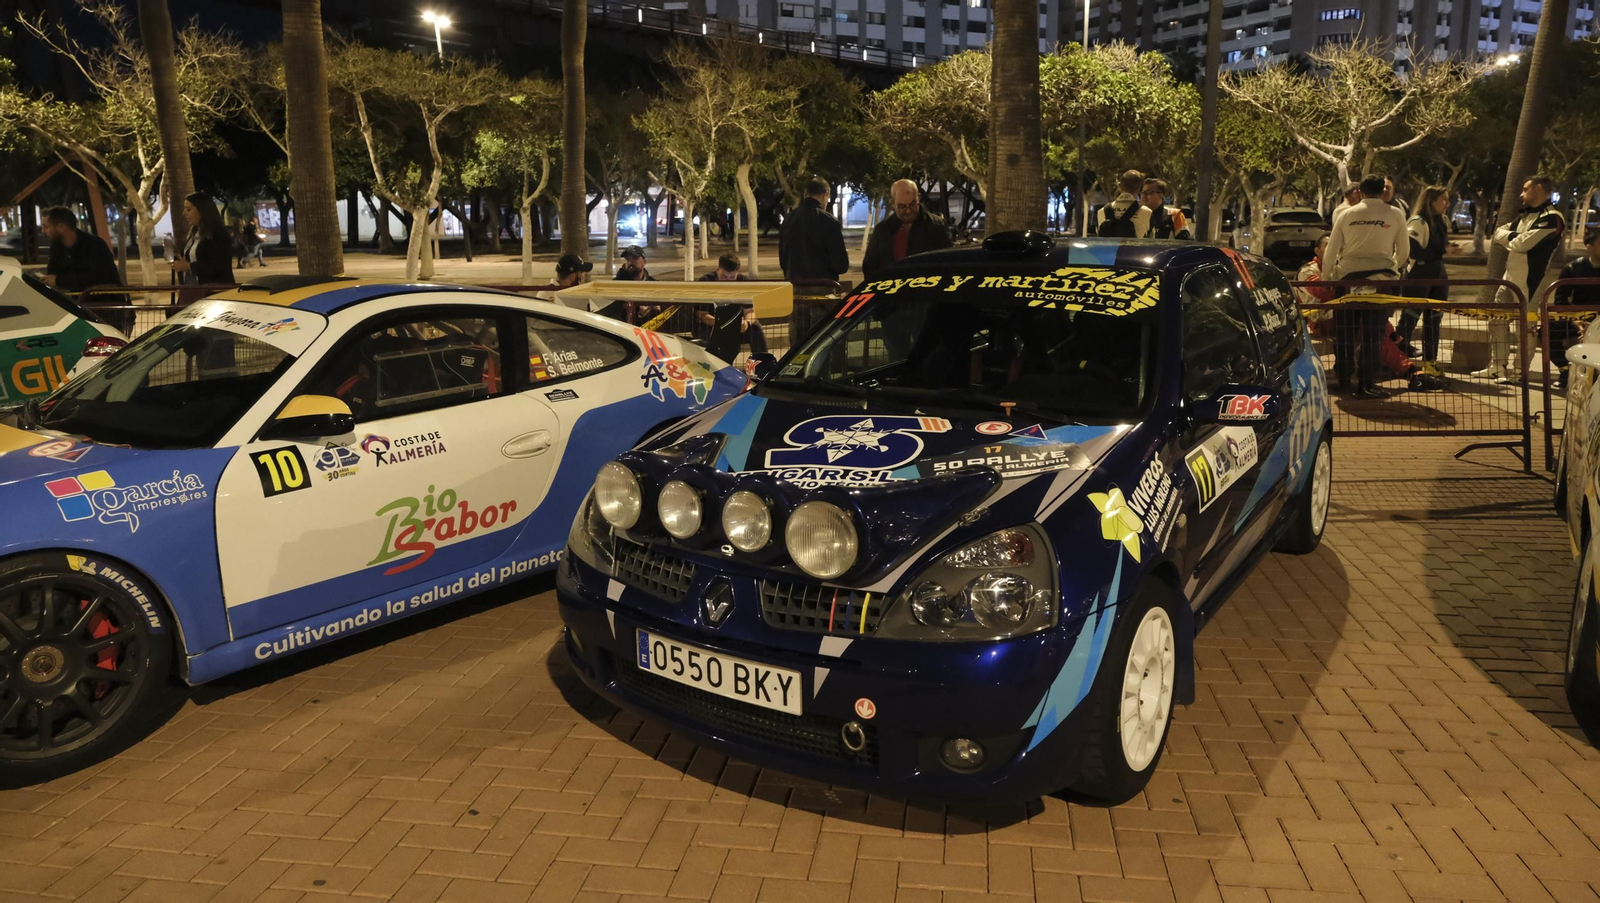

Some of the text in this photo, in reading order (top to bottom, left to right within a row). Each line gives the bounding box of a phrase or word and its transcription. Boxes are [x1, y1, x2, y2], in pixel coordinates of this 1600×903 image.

[861, 274, 942, 294] reyes
[944, 275, 973, 292] y
[834, 293, 875, 319] 17
[1014, 289, 1126, 309] automóviles
[542, 350, 578, 365] F. Arias
[547, 357, 604, 378] S. Belmonte
[1217, 394, 1272, 414] TBK
[394, 431, 441, 448] COSTA DE
[984, 446, 1002, 454] 17
[389, 441, 447, 464] ALMERÍA
[934, 450, 1067, 471] 50 RALLYE
[1005, 457, 1069, 471] ALMERIA
[258, 450, 304, 491] 10
[327, 470, 339, 481] 30
[1191, 455, 1212, 502] 17
[1128, 451, 1163, 516] VIVEROS
[92, 470, 205, 533] garcía
[133, 490, 208, 512] impresores
[1144, 505, 1160, 533] LUIS
[1153, 473, 1172, 512] MORENO
[366, 485, 457, 566] Bio
[384, 500, 517, 575] Sabor
[100, 566, 161, 628] MICHELIN
[254, 609, 382, 660] Cultivando
[387, 600, 405, 616] la
[410, 578, 463, 608] salud
[468, 567, 496, 590] del
[653, 640, 723, 688] 0550
